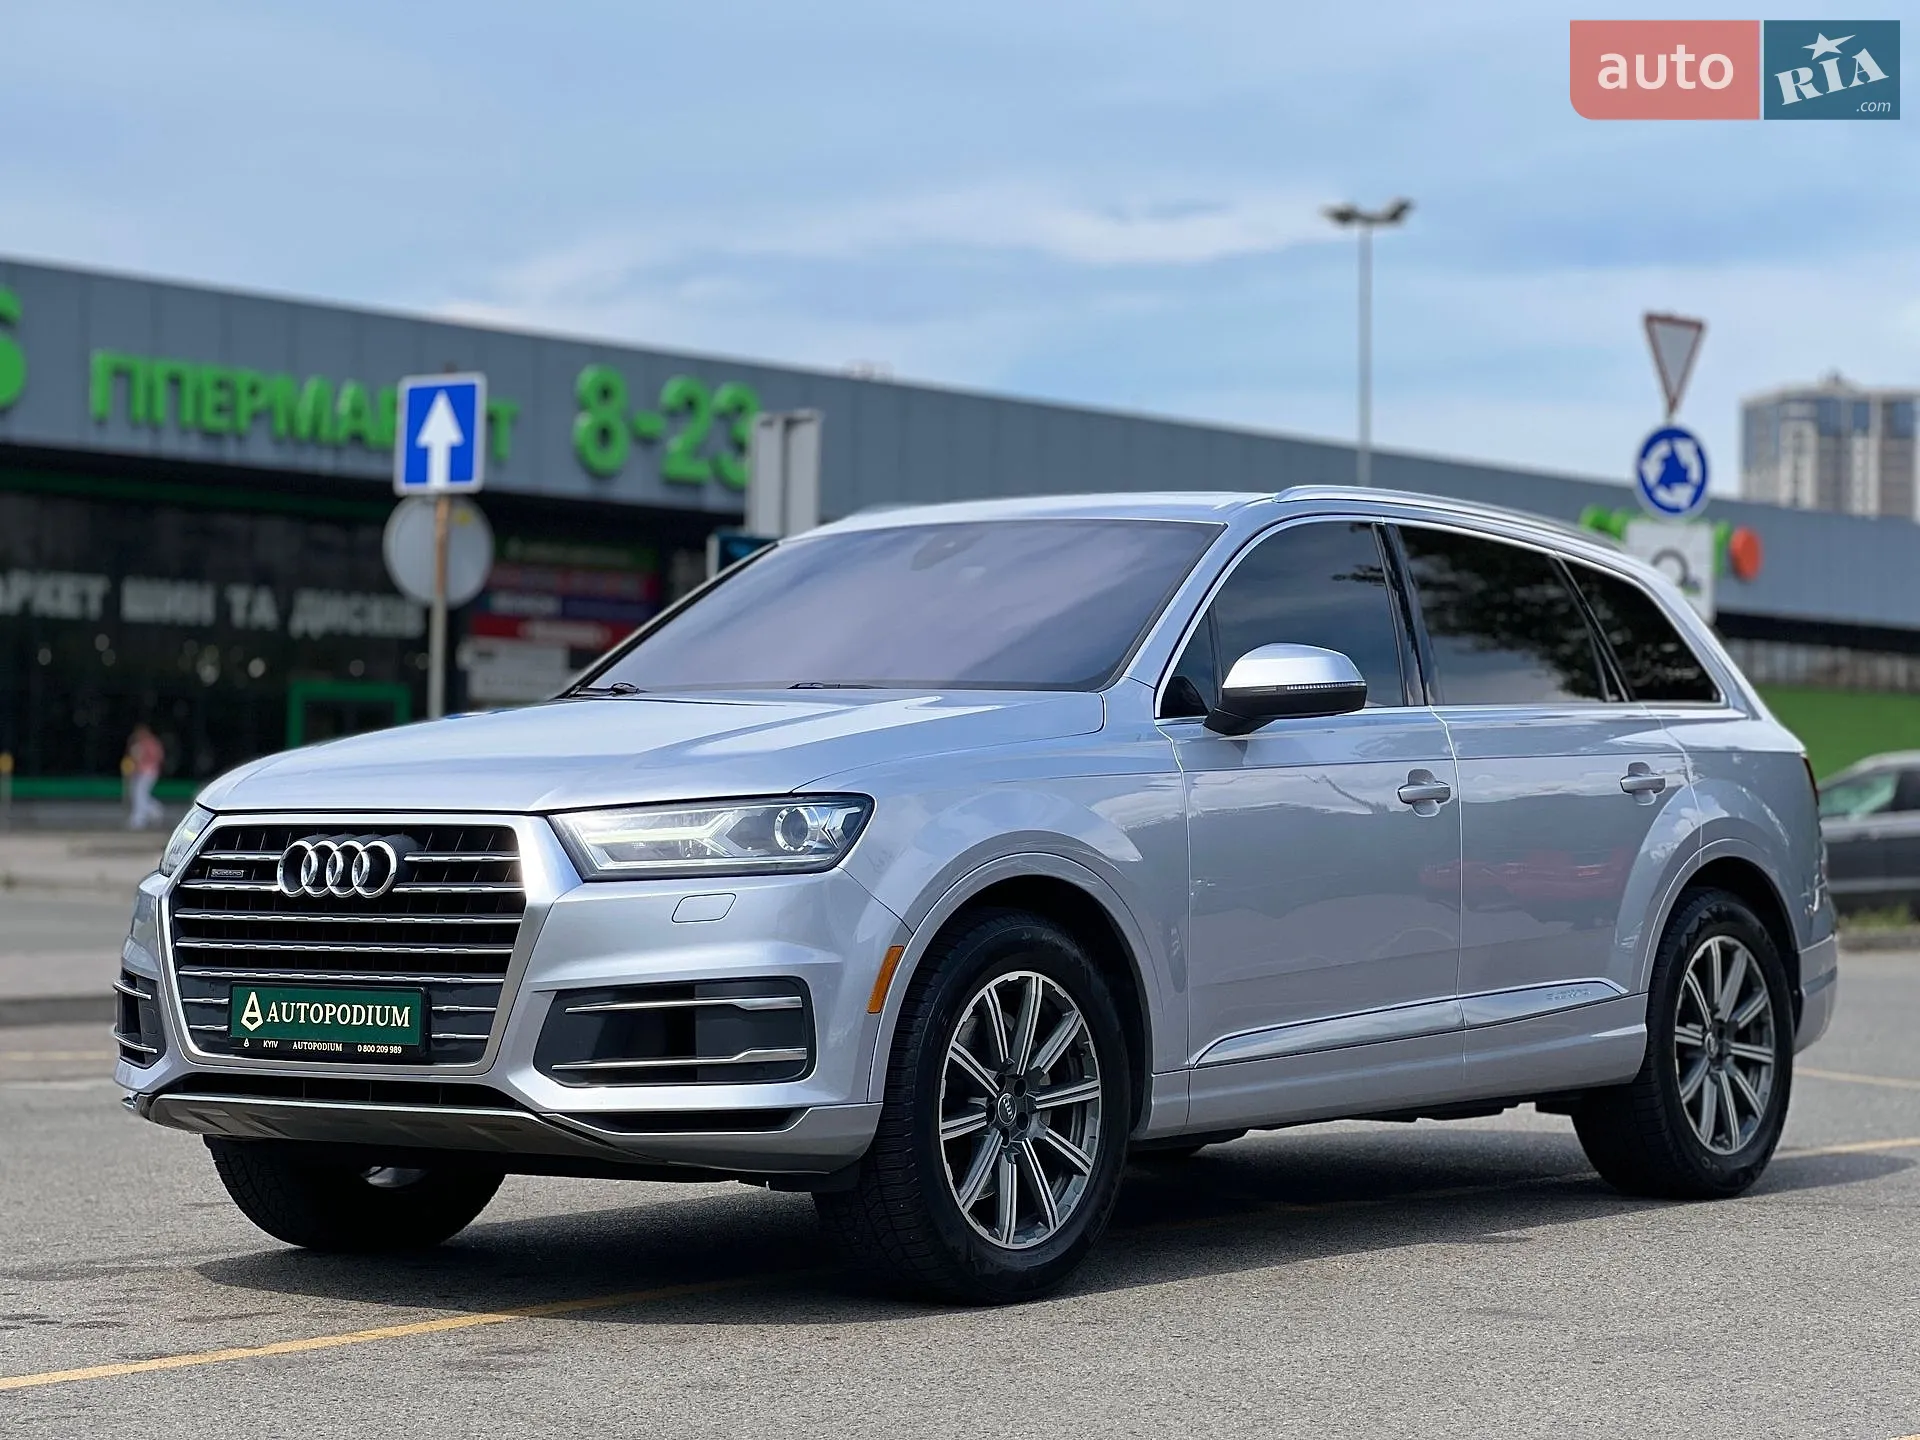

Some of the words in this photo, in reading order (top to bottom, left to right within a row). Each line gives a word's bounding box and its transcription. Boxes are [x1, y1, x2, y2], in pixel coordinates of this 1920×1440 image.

[91, 349, 518, 461] ГІПЕРМАТ
[573, 362, 761, 490] 8-23
[266, 1001, 411, 1028] AUTOPODIUM
[263, 1039, 278, 1048] KYIV
[292, 1041, 343, 1052] AUTOPODIUM
[357, 1044, 363, 1052] 0
[363, 1044, 376, 1053] 800
[376, 1045, 389, 1053] 209
[389, 1045, 402, 1054] 989
